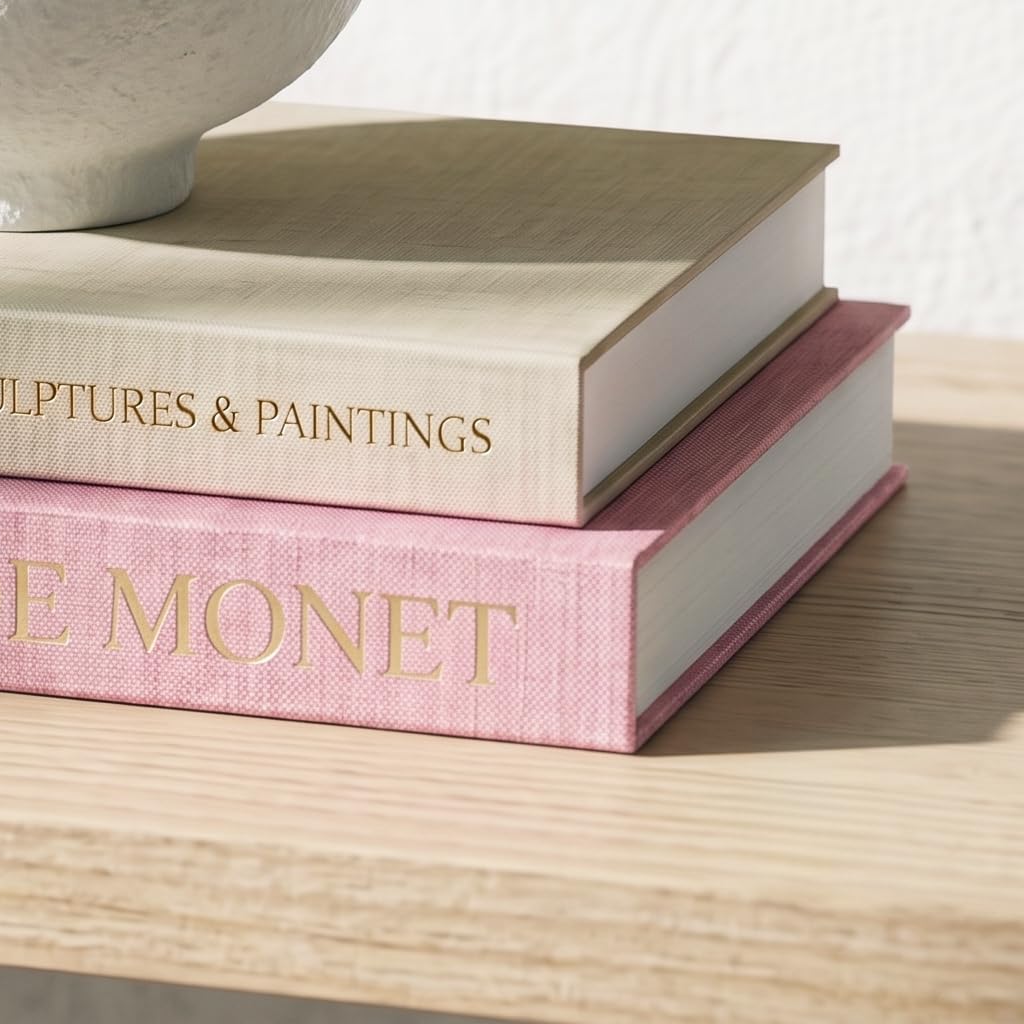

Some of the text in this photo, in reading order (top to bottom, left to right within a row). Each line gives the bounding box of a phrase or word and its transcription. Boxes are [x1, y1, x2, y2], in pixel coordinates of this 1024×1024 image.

[210, 395, 240, 433] &
[255, 398, 493, 455] PAINTINGS
[103, 566, 518, 686] MONET
